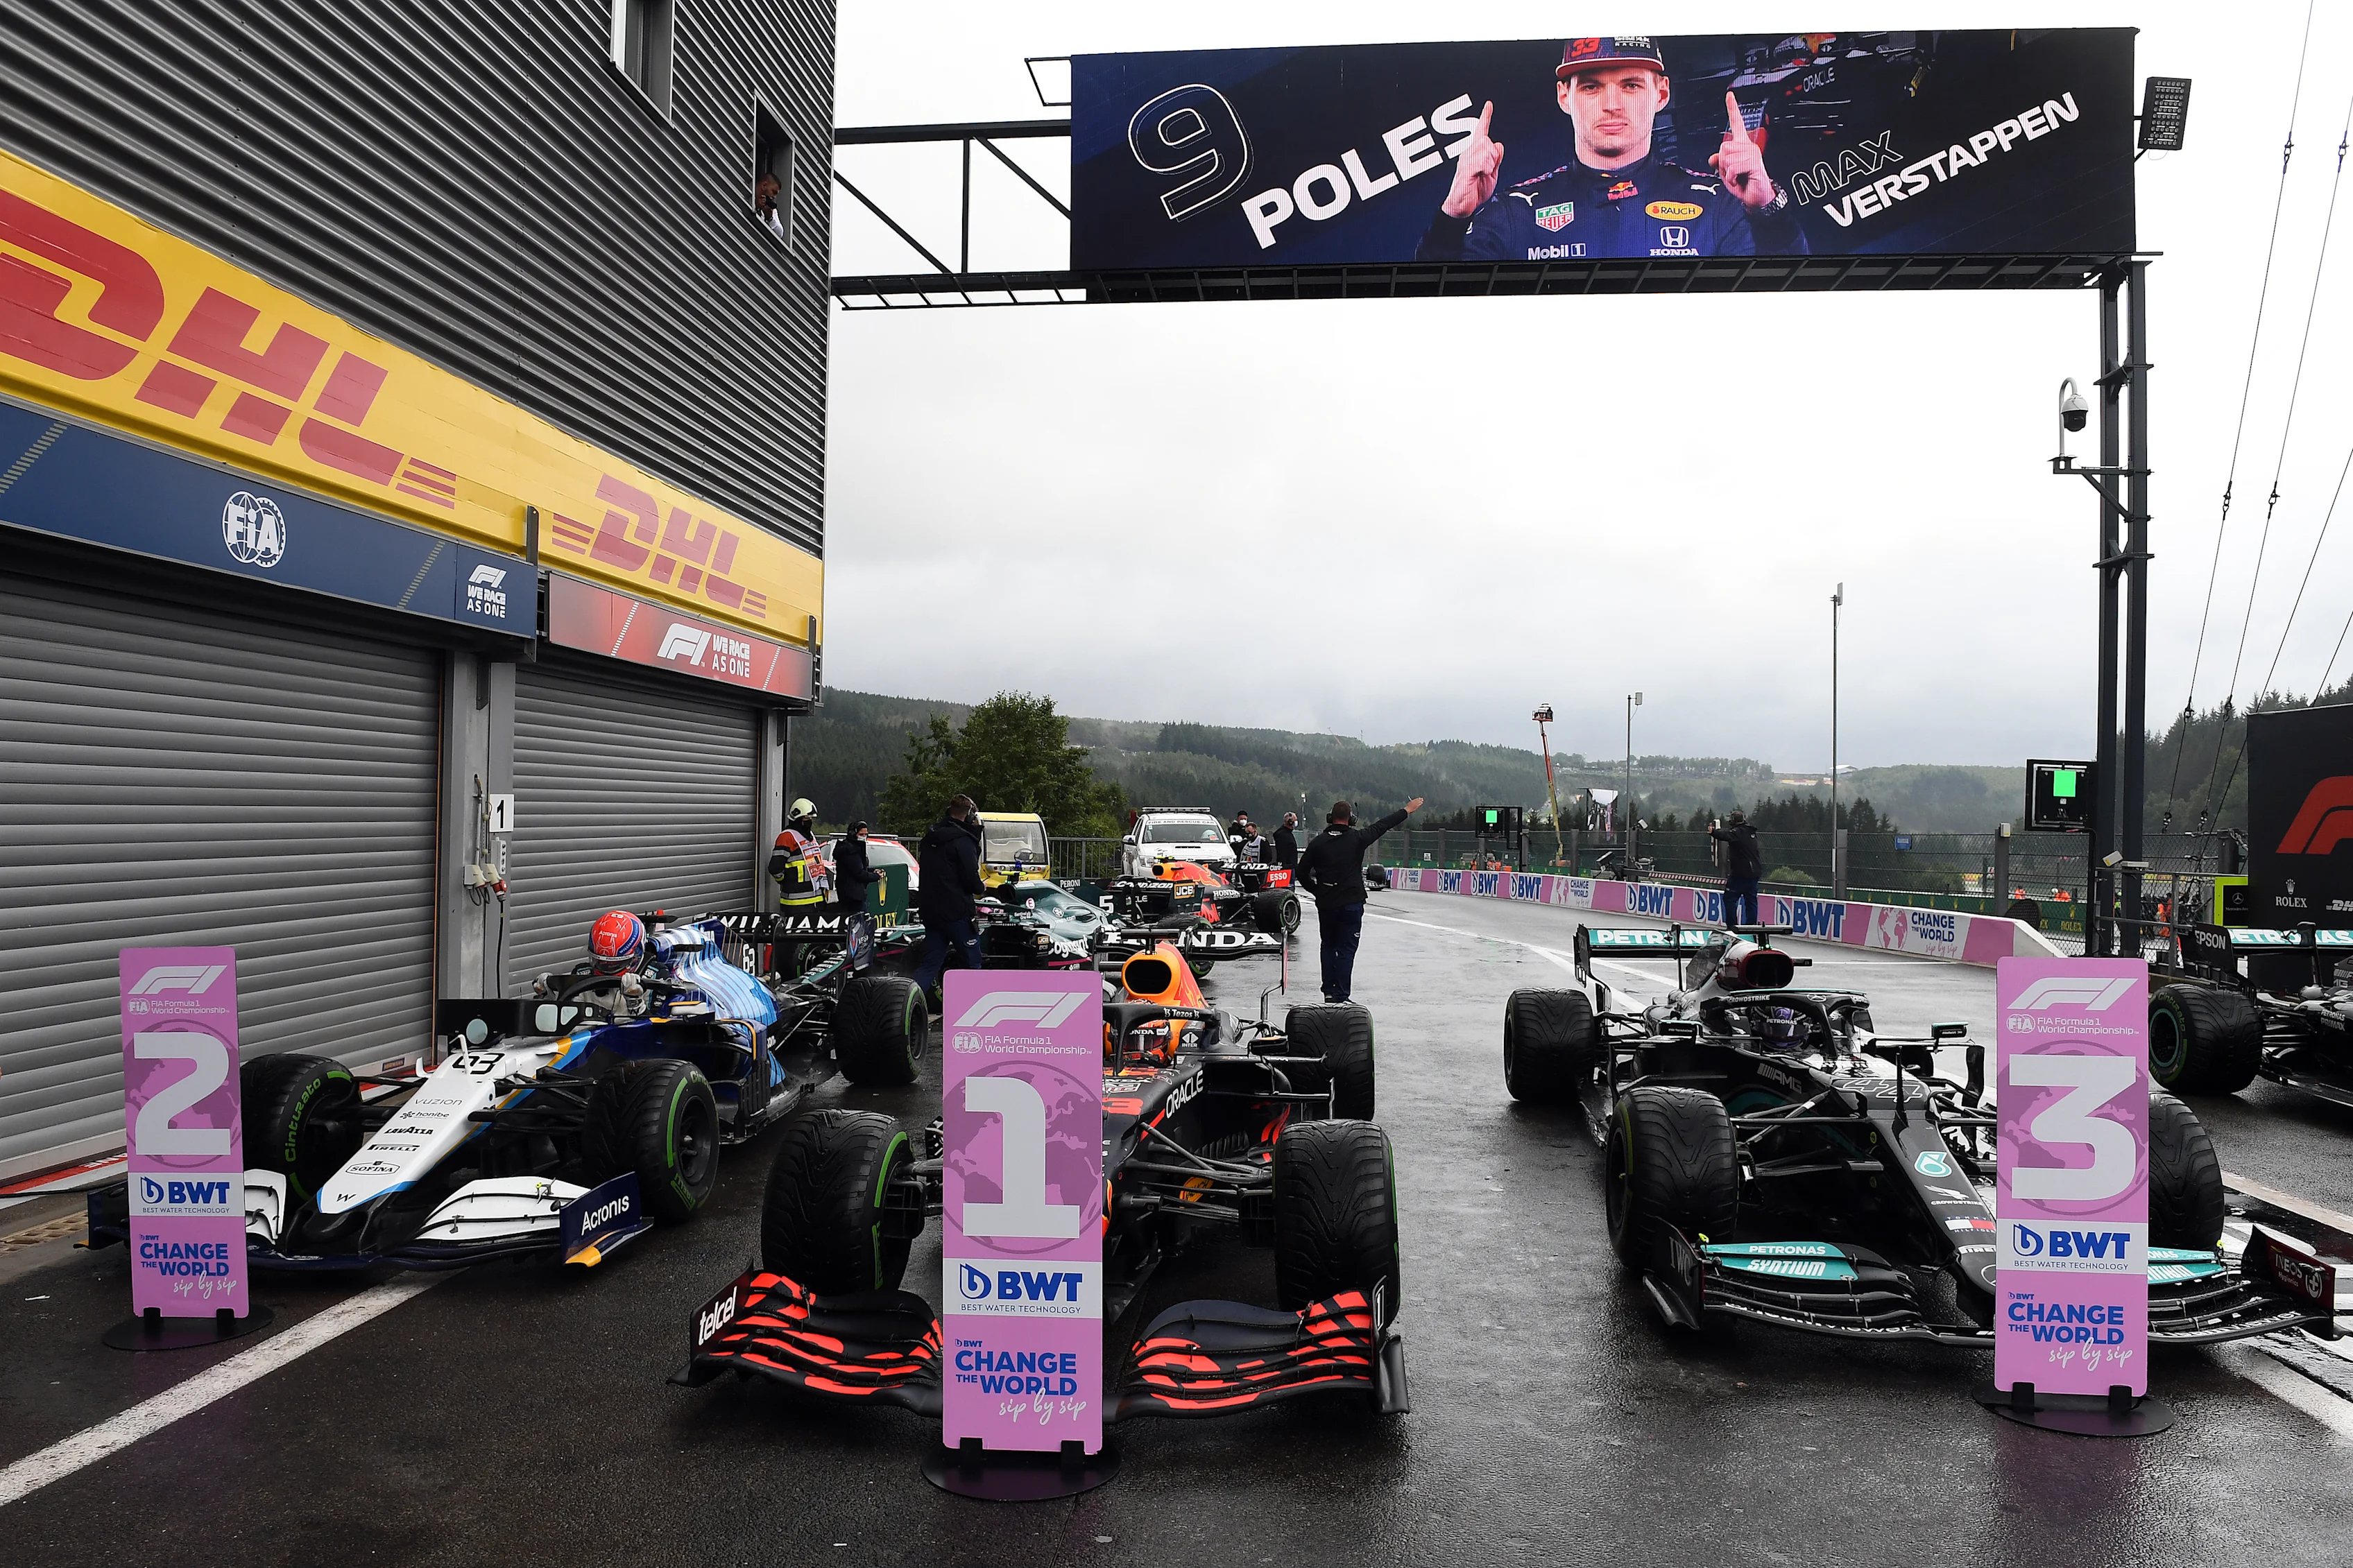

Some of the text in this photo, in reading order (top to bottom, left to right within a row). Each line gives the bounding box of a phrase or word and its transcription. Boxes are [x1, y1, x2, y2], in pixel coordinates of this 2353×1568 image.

[1803, 67, 1836, 93] ORACLE
[1128, 84, 1480, 248] 9 POLES
[1791, 130, 1903, 205] MAX
[1823, 92, 2080, 227] VERSTAPPEN
[1538, 202, 1571, 218] TAG
[1661, 207, 1695, 215] RAUCH
[1537, 215, 1572, 232] HEUER
[1528, 245, 1569, 260] Mobil
[0, 190, 404, 486] DHL
[590, 474, 744, 608] DHL
[468, 564, 507, 588] F1
[467, 585, 506, 605] WE RACE
[467, 598, 506, 619] AS ONE
[657, 623, 712, 666] F1
[712, 634, 750, 660] WE RACE
[712, 653, 750, 678] AS ONE
[497, 800, 504, 829] 1
[1060, 879, 1081, 888] PERONI
[1270, 872, 1287, 881] ESSO
[1444, 872, 1462, 892] BWT
[1478, 873, 1498, 894] BWT
[1570, 879, 1589, 890] CHANGE
[1176, 886, 1194, 895] JCB
[1518, 876, 1542, 901] BWT
[1573, 890, 1589, 898] WORLD
[1100, 895, 1114, 914] 5
[1638, 885, 1673, 916] BWT
[2275, 896, 2308, 908] ROLEX
[1793, 901, 1846, 938] BWT
[1912, 911, 1955, 929] CHANGE
[2061, 920, 2082, 932] ROLEX
[1919, 929, 1955, 942] WORLD
[2194, 930, 2226, 950] EPSON
[128, 965, 228, 994] F1
[1728, 995, 1770, 1003] CROWDSTRIKE
[2007, 977, 2139, 1010] F1
[952, 991, 1092, 1028] F1
[1172, 1009, 1192, 1018] Tezos
[2158, 992, 2187, 1032] Cinturato
[2321, 1009, 2345, 1022] PETRONAS
[984, 1035, 1052, 1044] FIA Formula 1
[984, 1044, 1015, 1053] World
[134, 1032, 231, 1155] 2
[1166, 1070, 1204, 1119] ORACLE
[1842, 1079, 1923, 1103] 44
[285, 1077, 322, 1162] Cinturato
[384, 1126, 434, 1135] LAVAZZA
[2010, 1054, 2136, 1200] 3
[366, 1144, 420, 1152] PIRELLI
[963, 1076, 1080, 1239] 1
[350, 1165, 394, 1173] SOFINA
[168, 1182, 230, 1204] BWT
[581, 1195, 630, 1236] Acronis
[140, 1243, 228, 1259] CHANGE
[1749, 1246, 1826, 1255] PETRONAS
[2049, 1231, 2130, 1259] BWT
[159, 1261, 229, 1276] WORLD
[1668, 1236, 1691, 1287] IWC
[1747, 1259, 1826, 1277] SYNTIUM
[2069, 1262, 2128, 1270] TECHNOLOGY
[2275, 1254, 2302, 1279] INEOS
[173, 1270, 237, 1300] sip by sip
[998, 1271, 1083, 1302] BWT
[699, 1286, 737, 1346] telcel
[1018, 1305, 1081, 1314] TECHNOLOGY
[2008, 1302, 2124, 1325] CHANGE
[2008, 1324, 2124, 1345] THE WORLD
[955, 1350, 1077, 1374] CHANGE
[2048, 1337, 2133, 1371] sip by sip
[956, 1374, 1077, 1396] THE WORLD
[999, 1387, 1087, 1425] sip by sip
